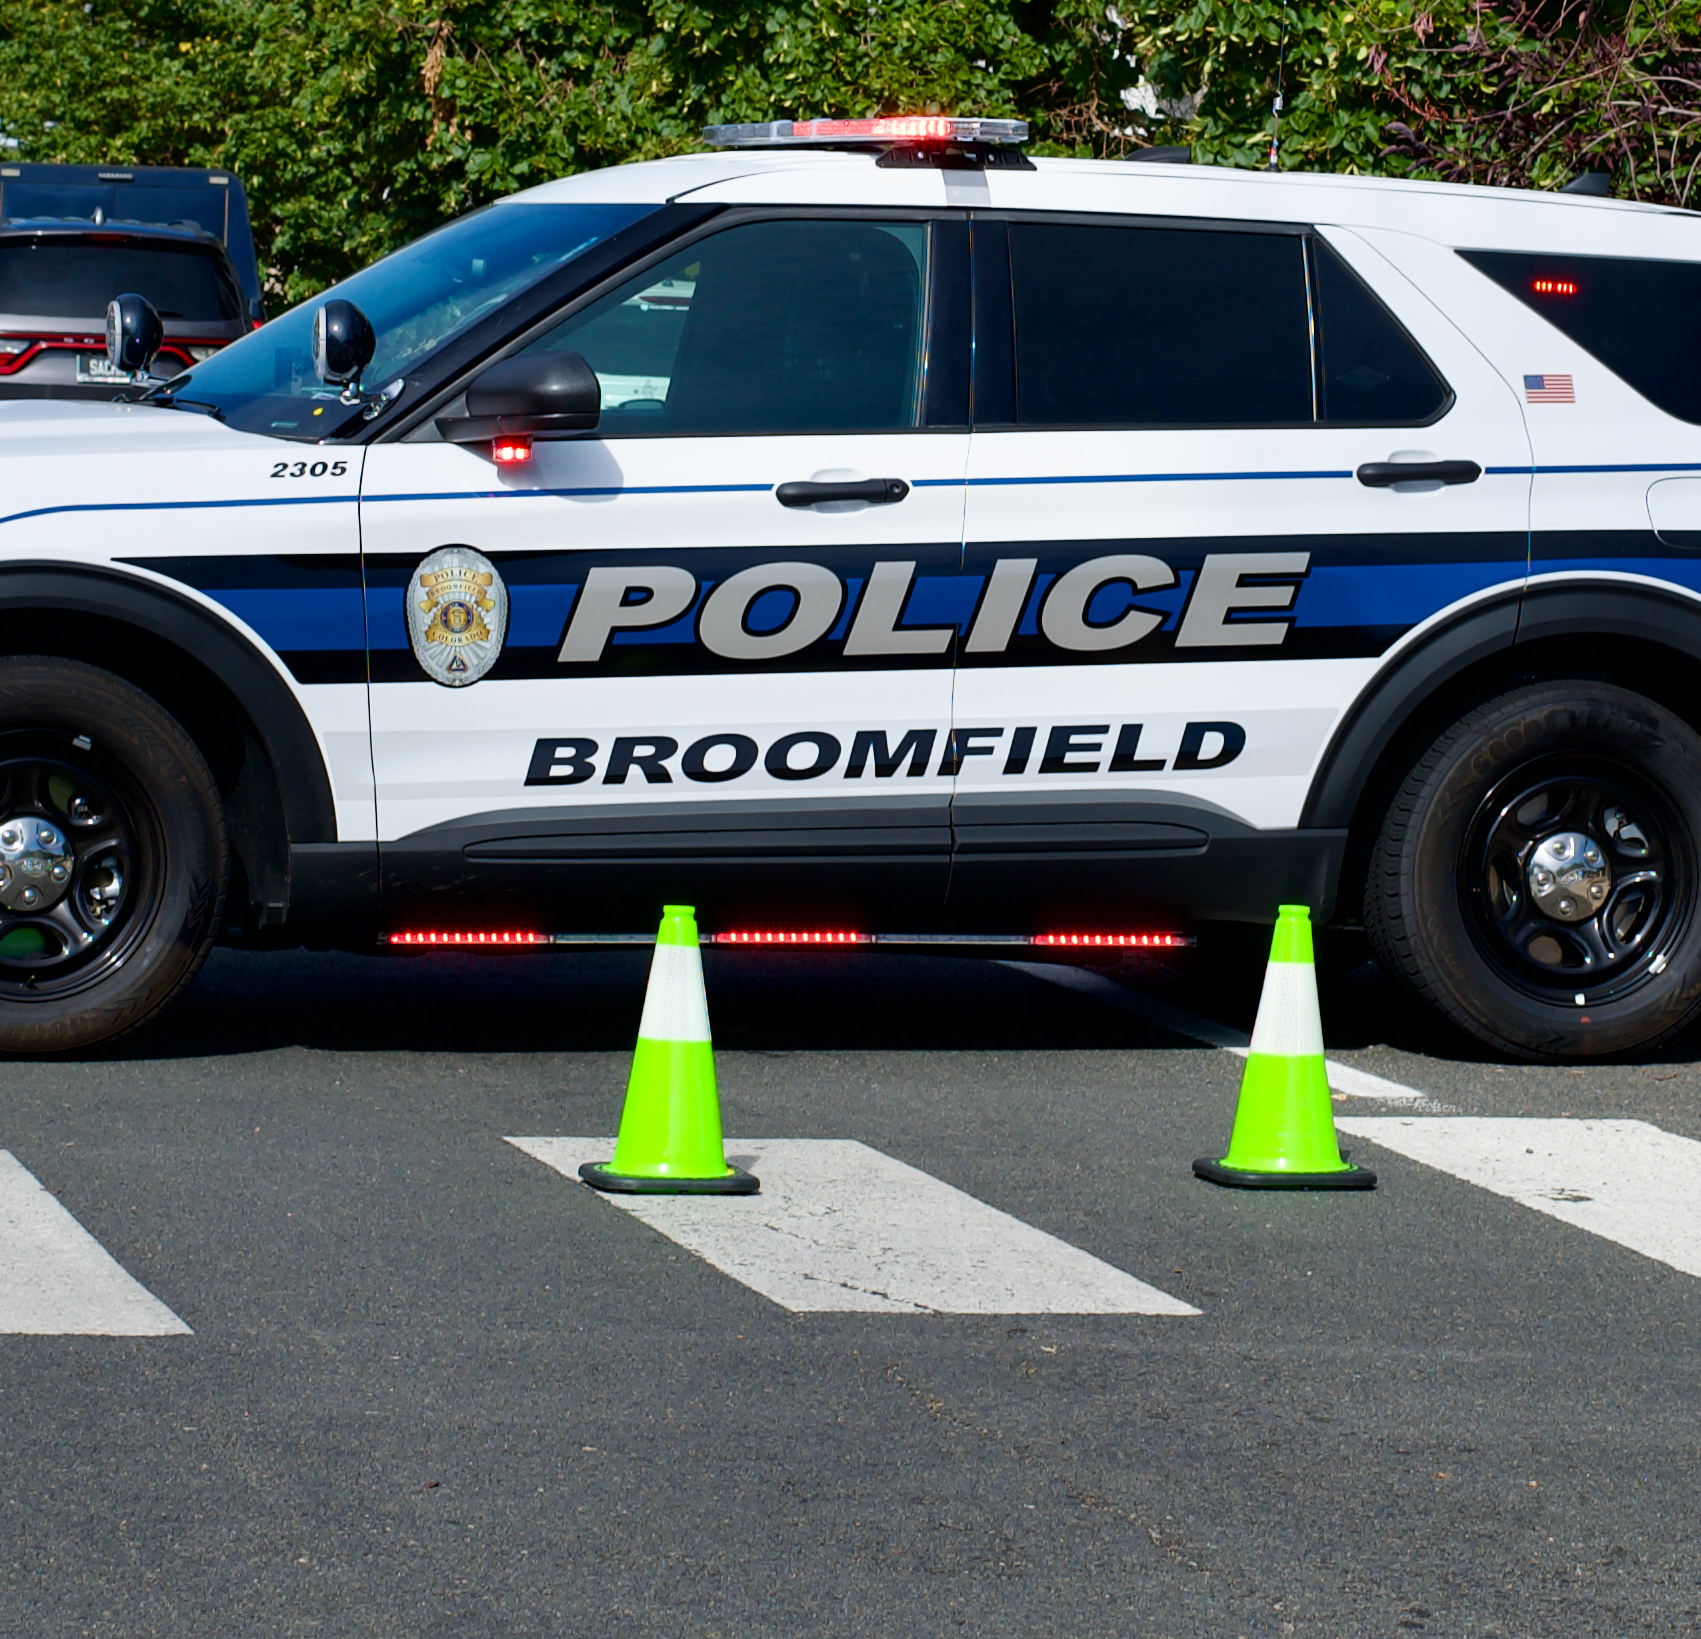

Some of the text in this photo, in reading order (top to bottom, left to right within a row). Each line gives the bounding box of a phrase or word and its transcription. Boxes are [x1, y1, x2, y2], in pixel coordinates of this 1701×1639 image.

[269, 461, 348, 478] 2305
[433, 568, 480, 583] POLICE
[557, 551, 1310, 663] POLICE
[431, 629, 484, 644] COLORADO
[523, 720, 1247, 787] BROOMFIELD
